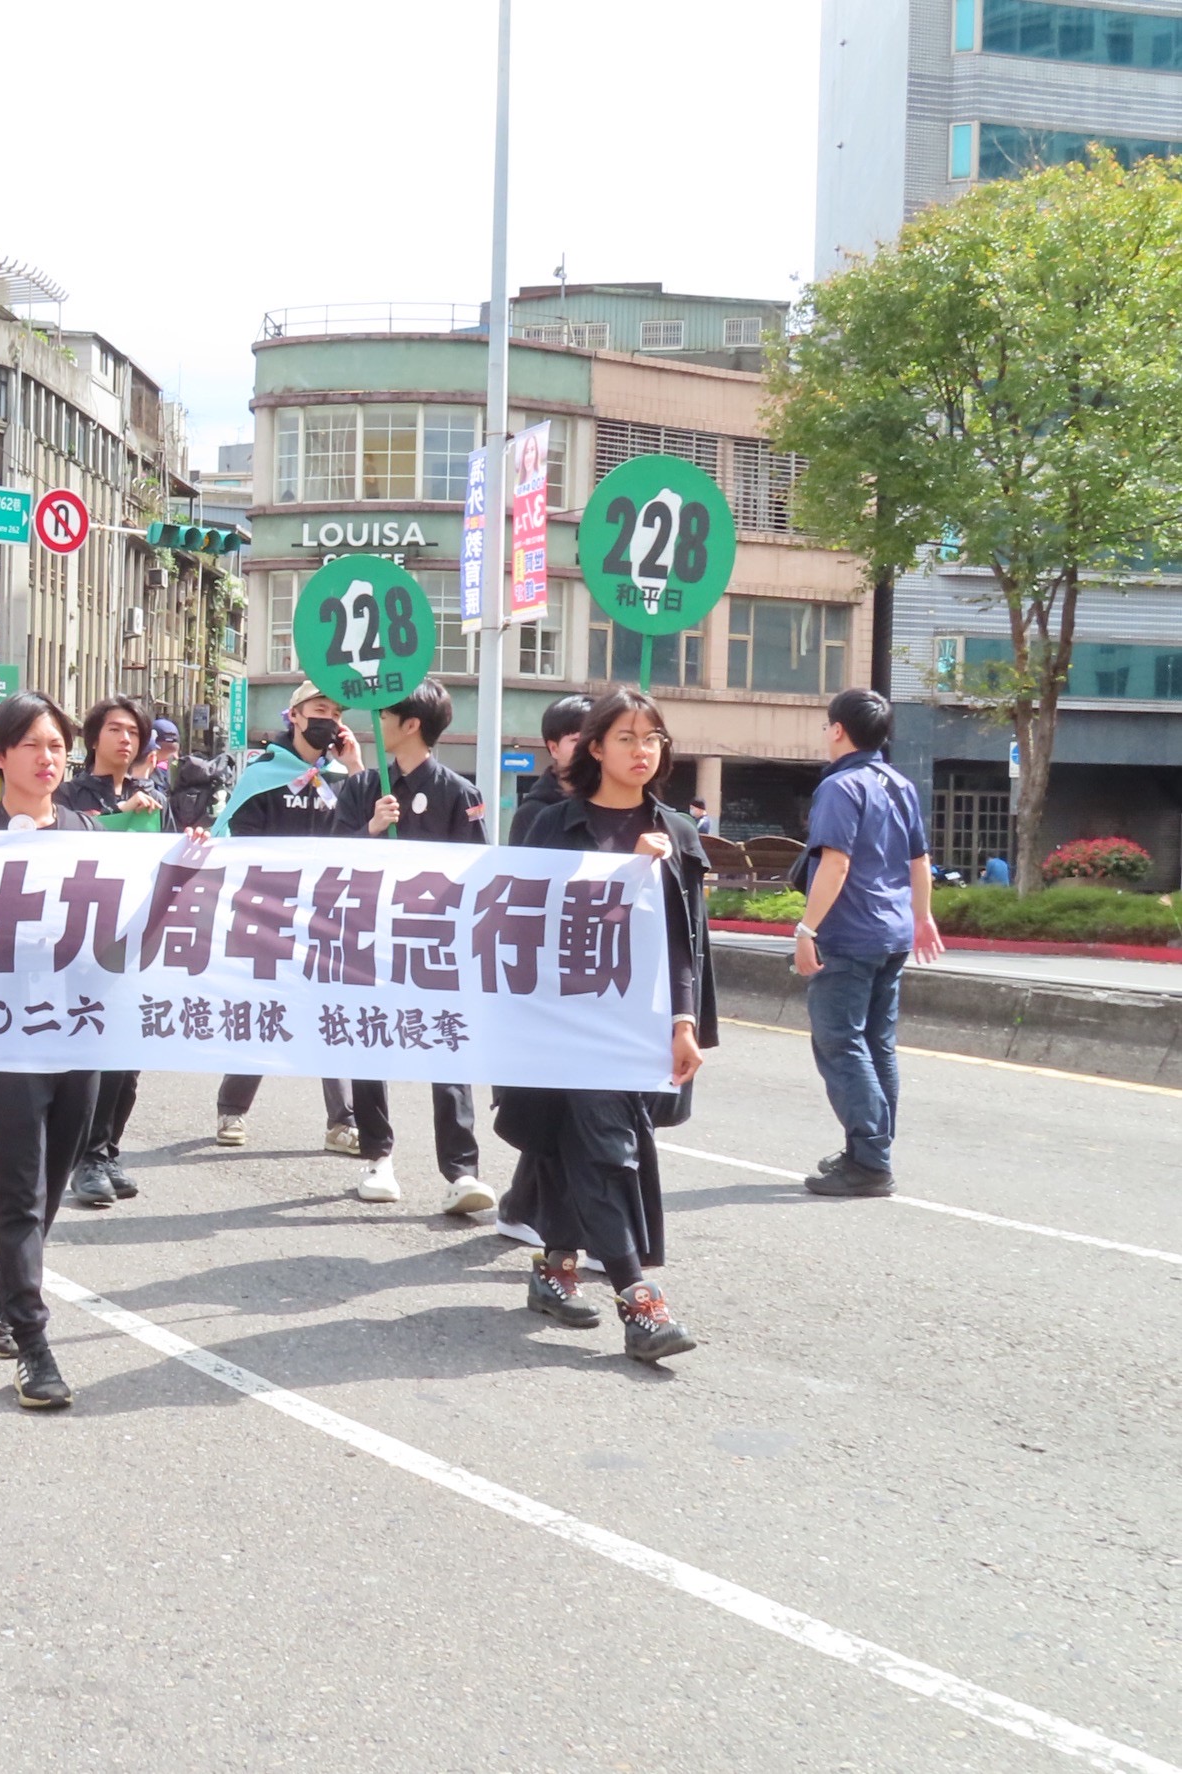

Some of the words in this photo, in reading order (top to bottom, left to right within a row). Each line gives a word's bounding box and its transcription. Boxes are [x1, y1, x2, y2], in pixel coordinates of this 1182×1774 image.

[8, 526, 20, 534] 262
[302, 522, 426, 547] LOUISA
[602, 496, 710, 584] 228
[616, 583, 683, 612] 和平日
[319, 586, 418, 666] 228
[341, 672, 403, 699] 和平日
[139, 994, 294, 1043] 記憶相依
[319, 1006, 470, 1052] 抵抗侵奪
